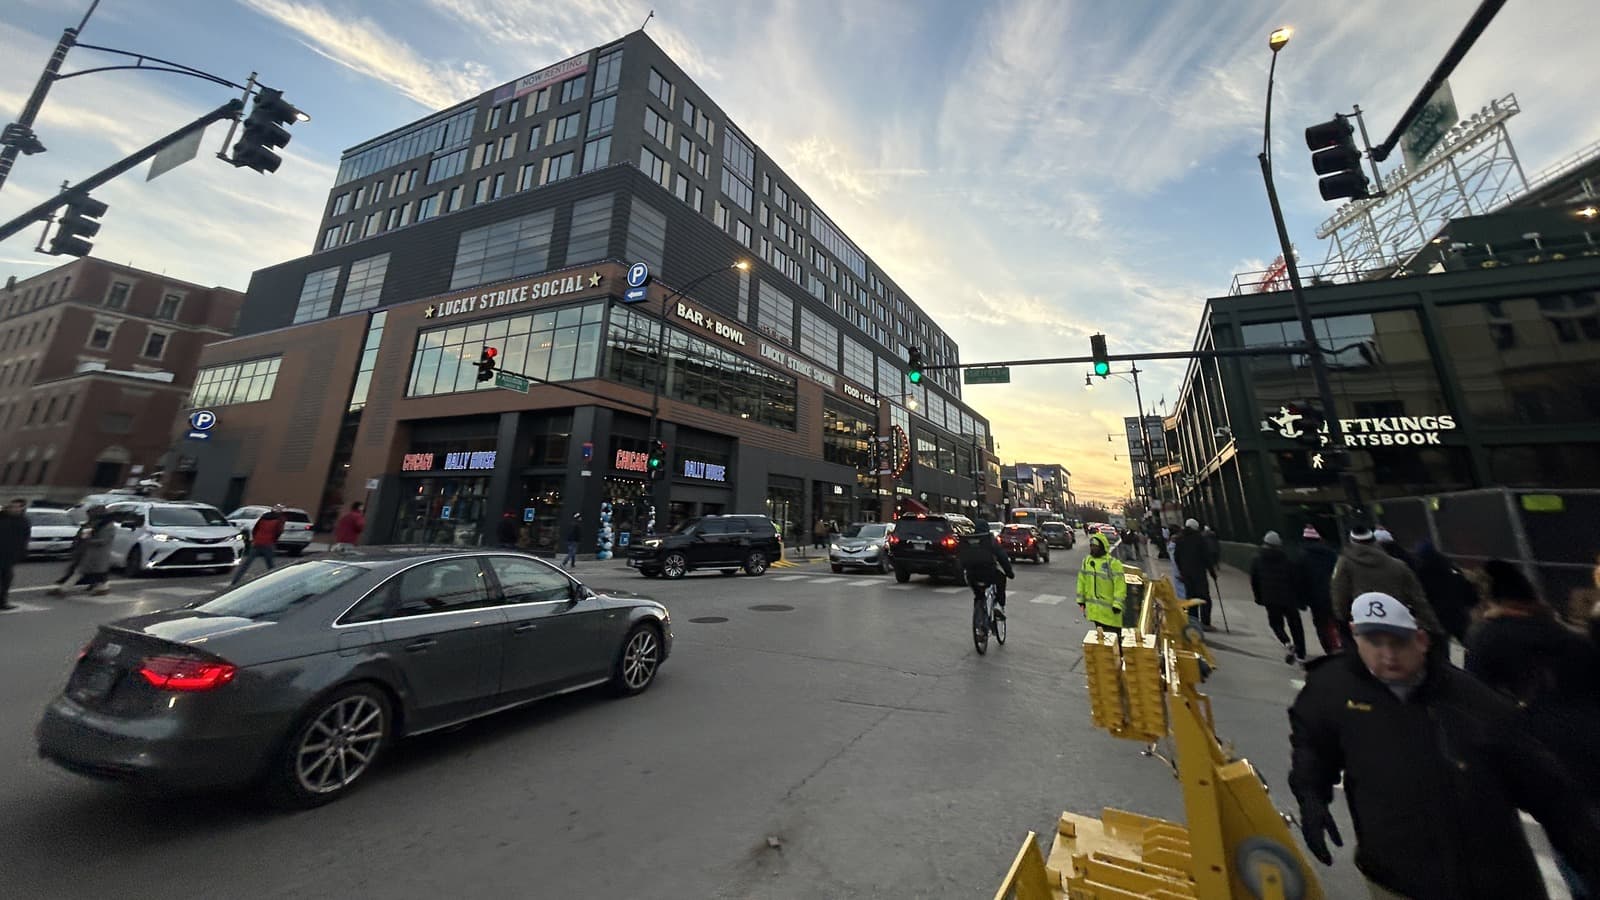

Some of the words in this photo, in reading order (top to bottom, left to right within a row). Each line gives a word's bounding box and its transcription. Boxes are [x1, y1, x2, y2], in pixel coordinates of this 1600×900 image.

[522, 74, 543, 87] NOW
[544, 59, 582, 77] RENTING
[632, 266, 644, 283] P
[437, 296, 477, 317] LUCKY
[479, 286, 528, 309] STRIKE
[531, 275, 584, 299] SOCIAL
[677, 302, 704, 327] BAR
[715, 320, 746, 346] BOWL
[844, 383, 860, 399] FOOD
[196, 413, 212, 426] P
[1317, 415, 1456, 434] FTKINGS
[1319, 432, 1441, 447] PRTSBOOK
[402, 453, 434, 471] CHICAGO
